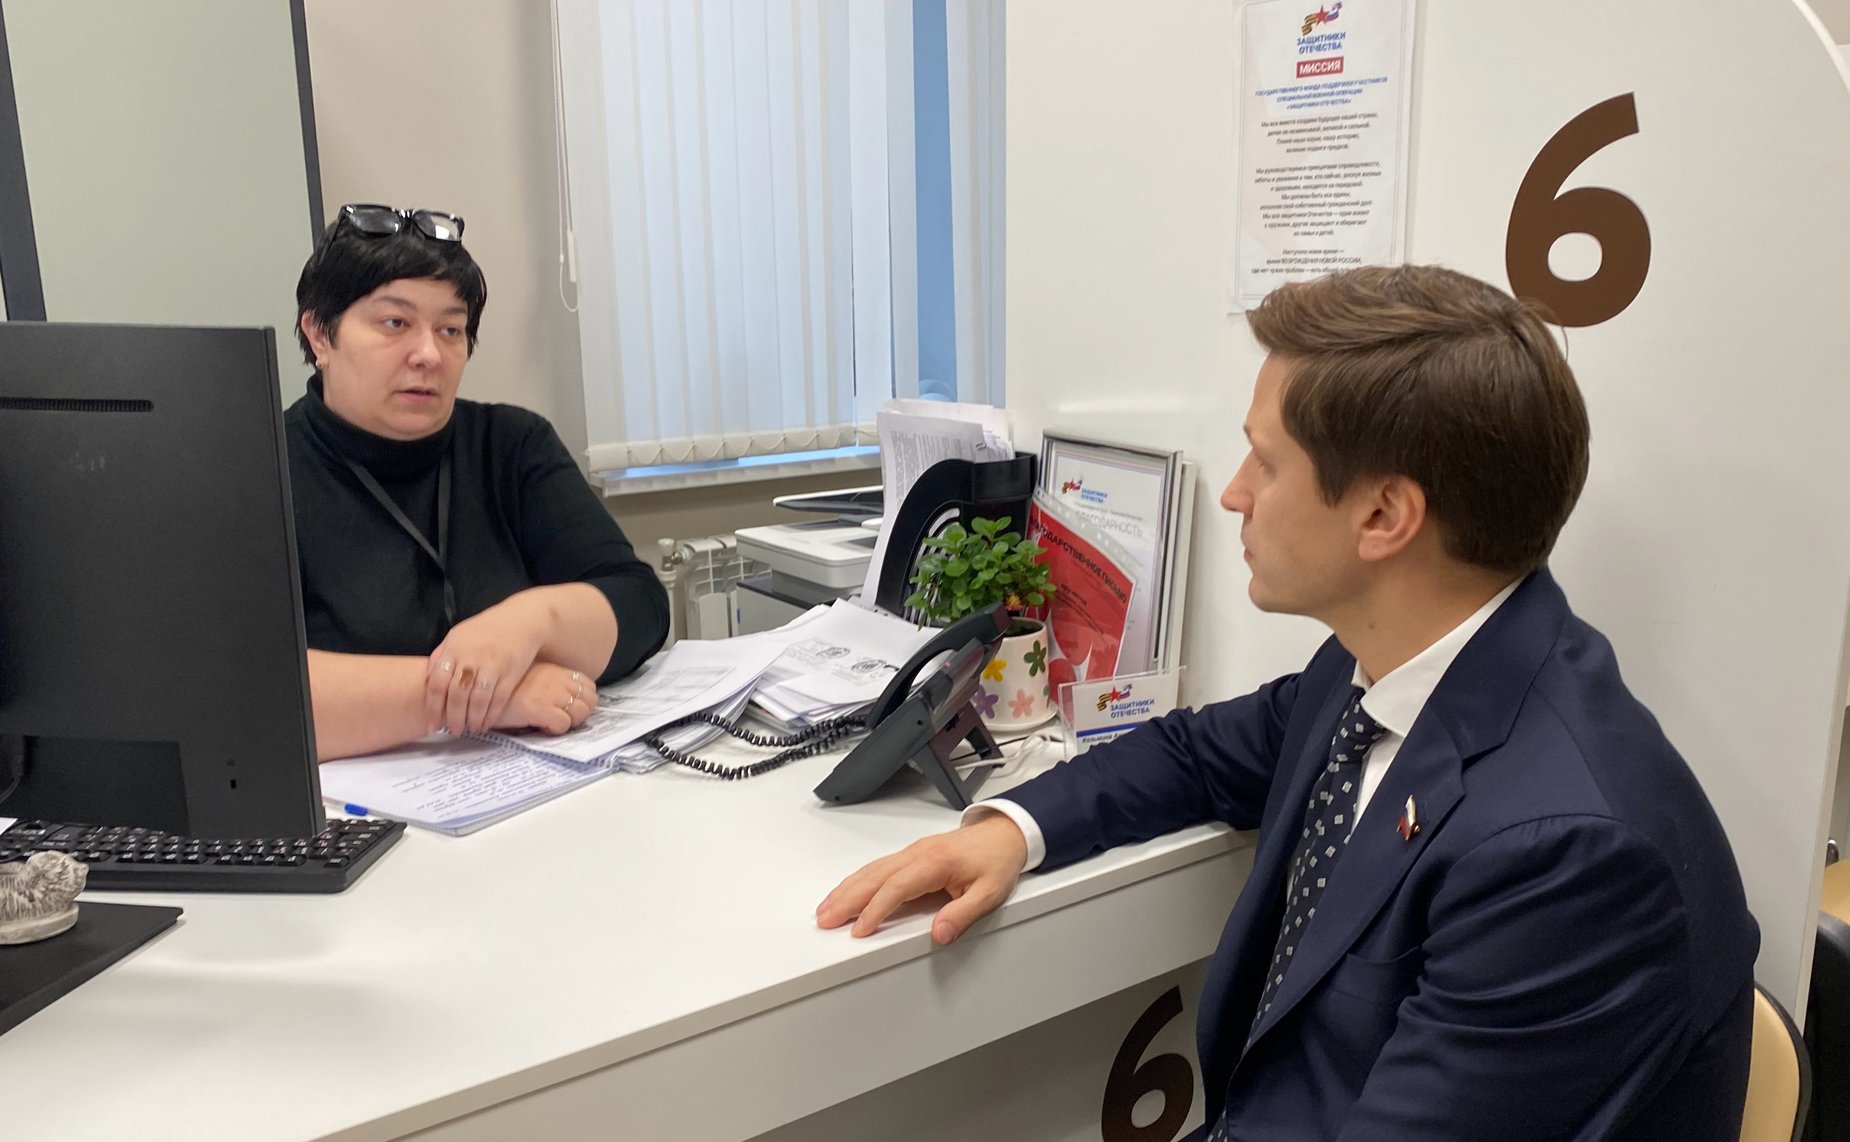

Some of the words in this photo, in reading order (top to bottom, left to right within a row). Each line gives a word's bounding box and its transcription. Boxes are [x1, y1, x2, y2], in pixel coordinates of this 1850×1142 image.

[1296, 32, 1346, 46] ЗАЩИТНИКИ
[1298, 42, 1342, 54] ОТЕЧЕСТВА
[1300, 59, 1341, 75] МИССИЯ
[1506, 91, 1652, 328] 6
[1102, 570, 1127, 603] ПИСЬМО
[1110, 699, 1154, 712] ЗАЩИТНИКИ
[1110, 707, 1150, 719] ОТЕЧЕСТВА
[1101, 984, 1194, 1142] 6
